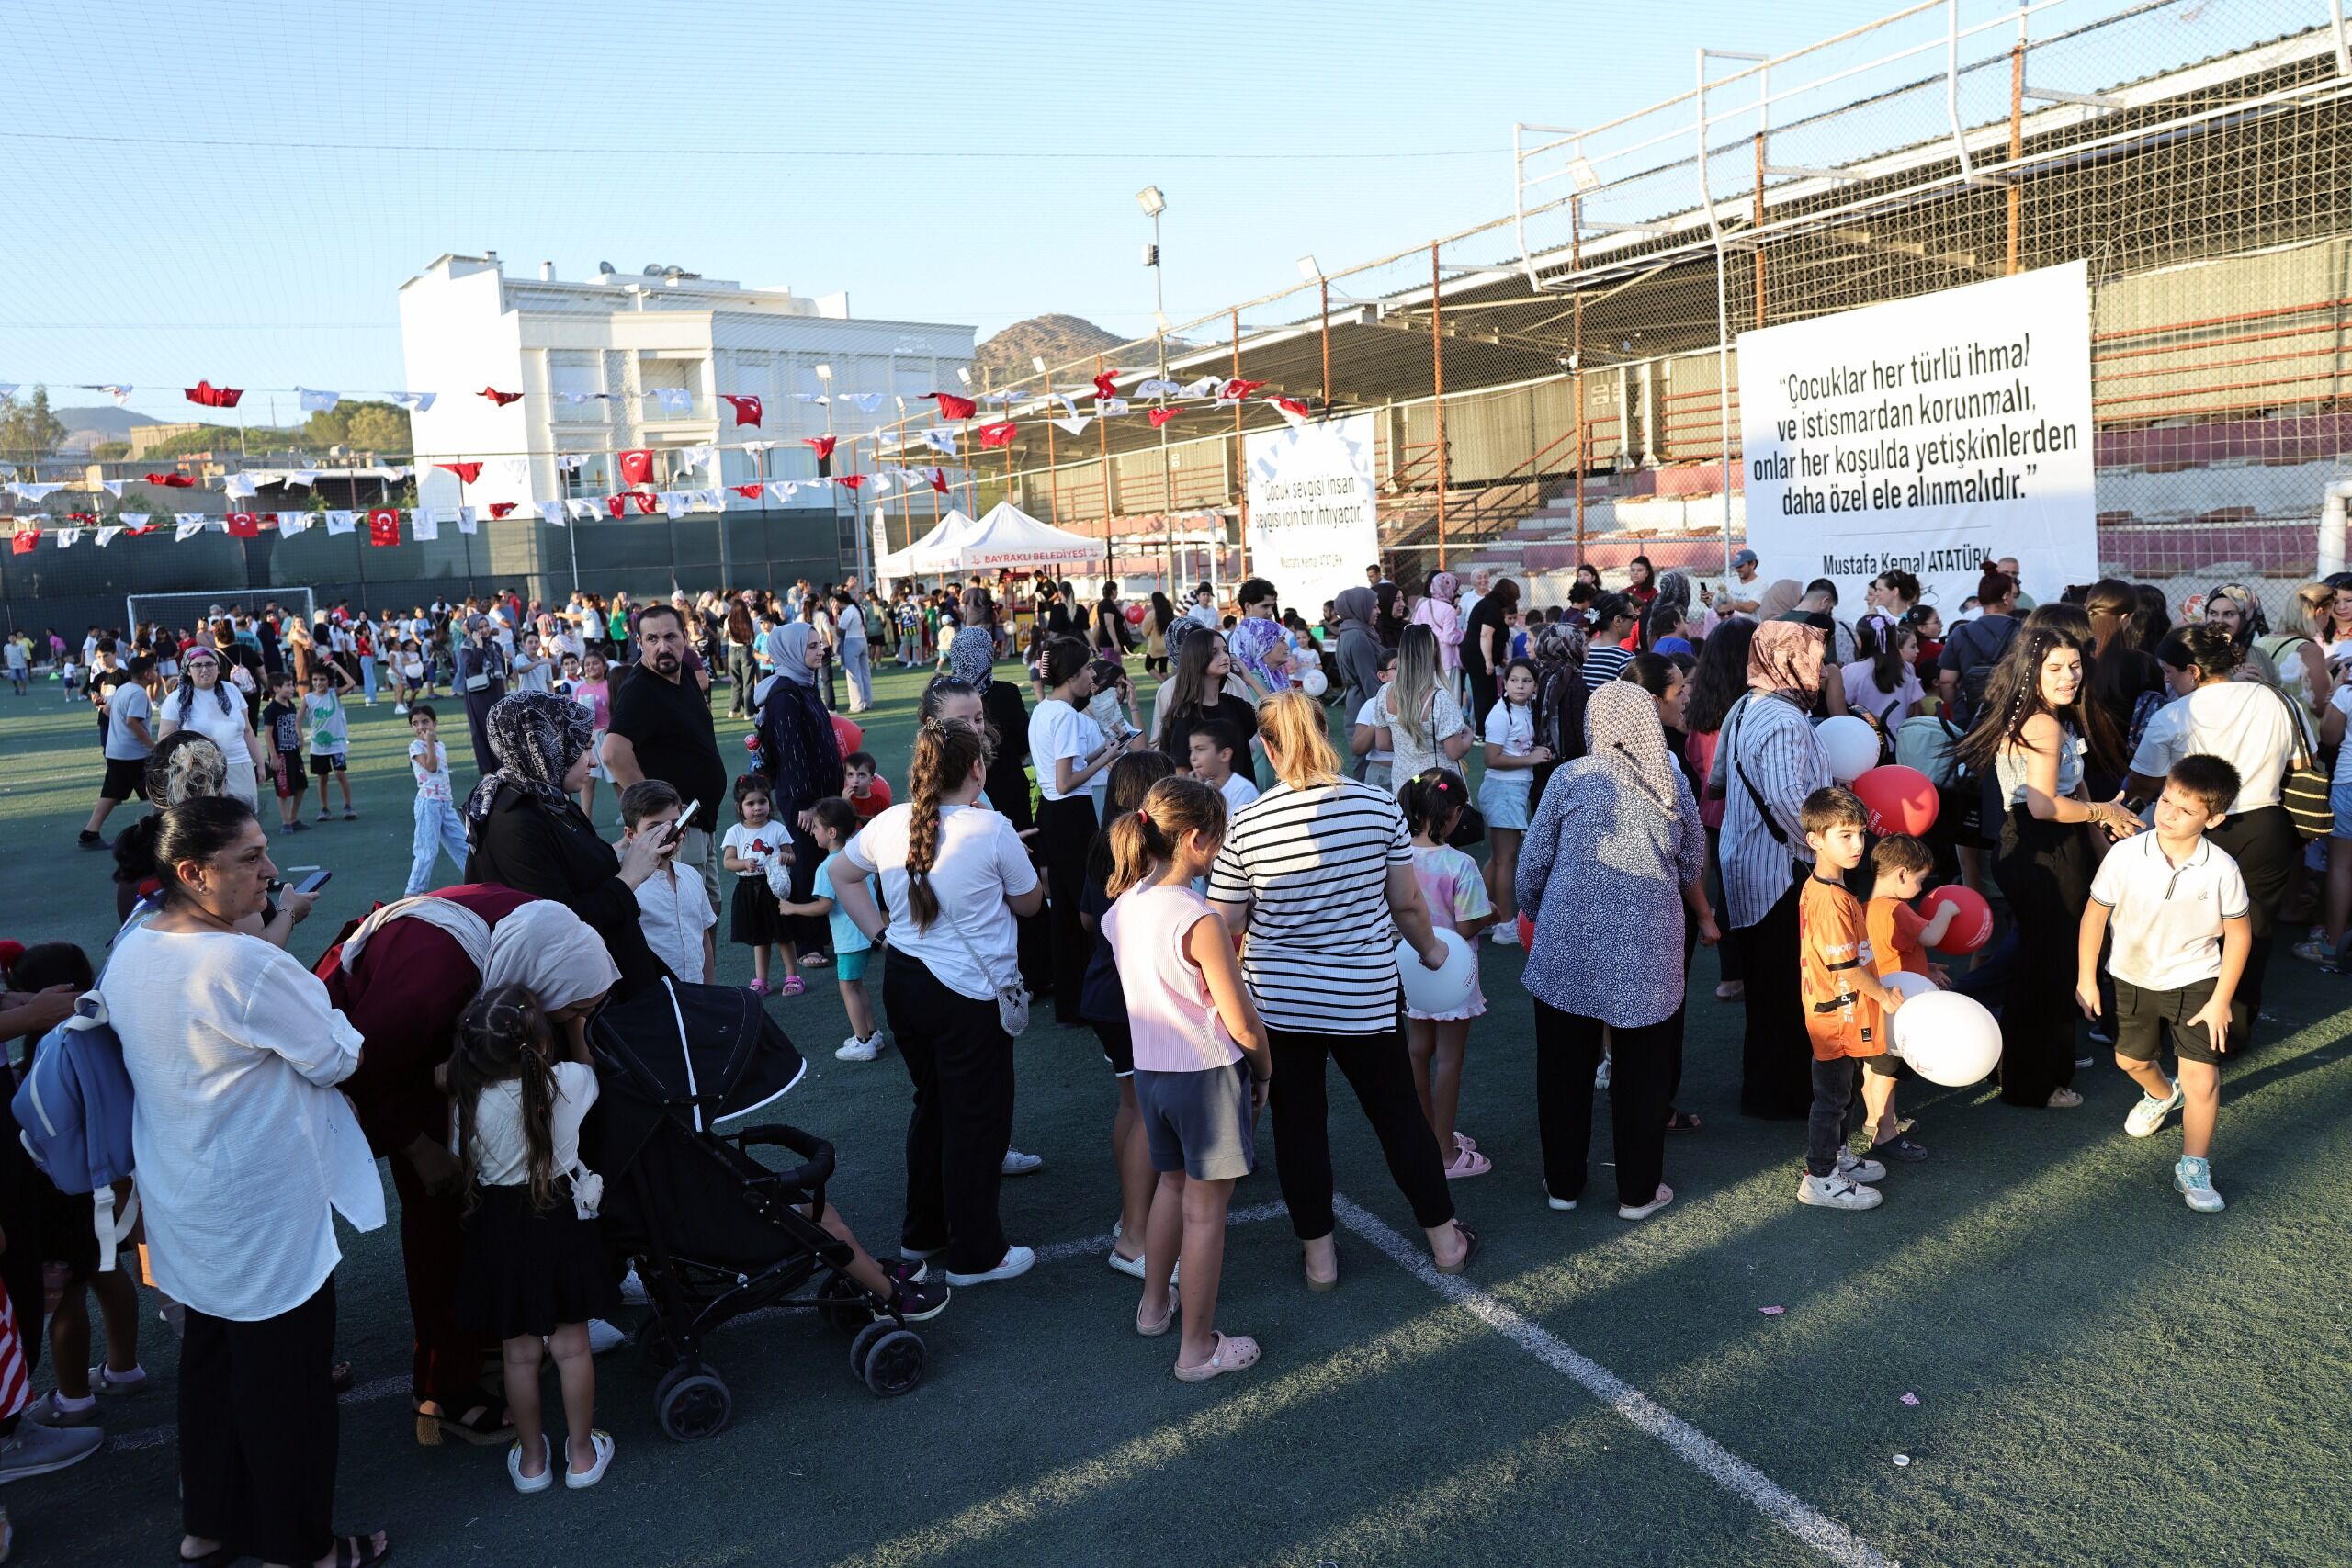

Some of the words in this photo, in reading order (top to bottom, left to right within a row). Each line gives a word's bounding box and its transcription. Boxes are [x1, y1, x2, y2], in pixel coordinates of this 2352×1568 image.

[1780, 366, 1867, 408] “Çocuklar
[1873, 359, 1905, 390] her
[1911, 351, 1962, 386] türlü
[1968, 333, 2030, 375] ihmal
[1778, 418, 1797, 442] ve
[1802, 399, 1914, 439] istismardan
[1920, 378, 2037, 426] korunmalı,
[1754, 451, 1794, 481] onlar
[1802, 447, 1829, 477] her
[1836, 437, 1910, 478] koşulda
[1916, 418, 2076, 473] yetişkinlerden
[1293, 474, 1325, 502] sevgisi
[1326, 473, 1354, 495] insan
[1782, 485, 1826, 516] daha
[1830, 479, 1867, 513] özel
[1873, 480, 1902, 511] ele
[1907, 464, 2038, 508] alınmalıdır.”
[1255, 507, 1281, 533] sevgisi
[1301, 503, 1314, 526] bir
[984, 554, 1031, 563] BAYRAKLI
[1034, 548, 1087, 560] BELEDİYESİ
[1823, 555, 1877, 575] Mustafa
[1882, 552, 1925, 574] Kemal
[1928, 543, 1992, 573] ATATÜRK
